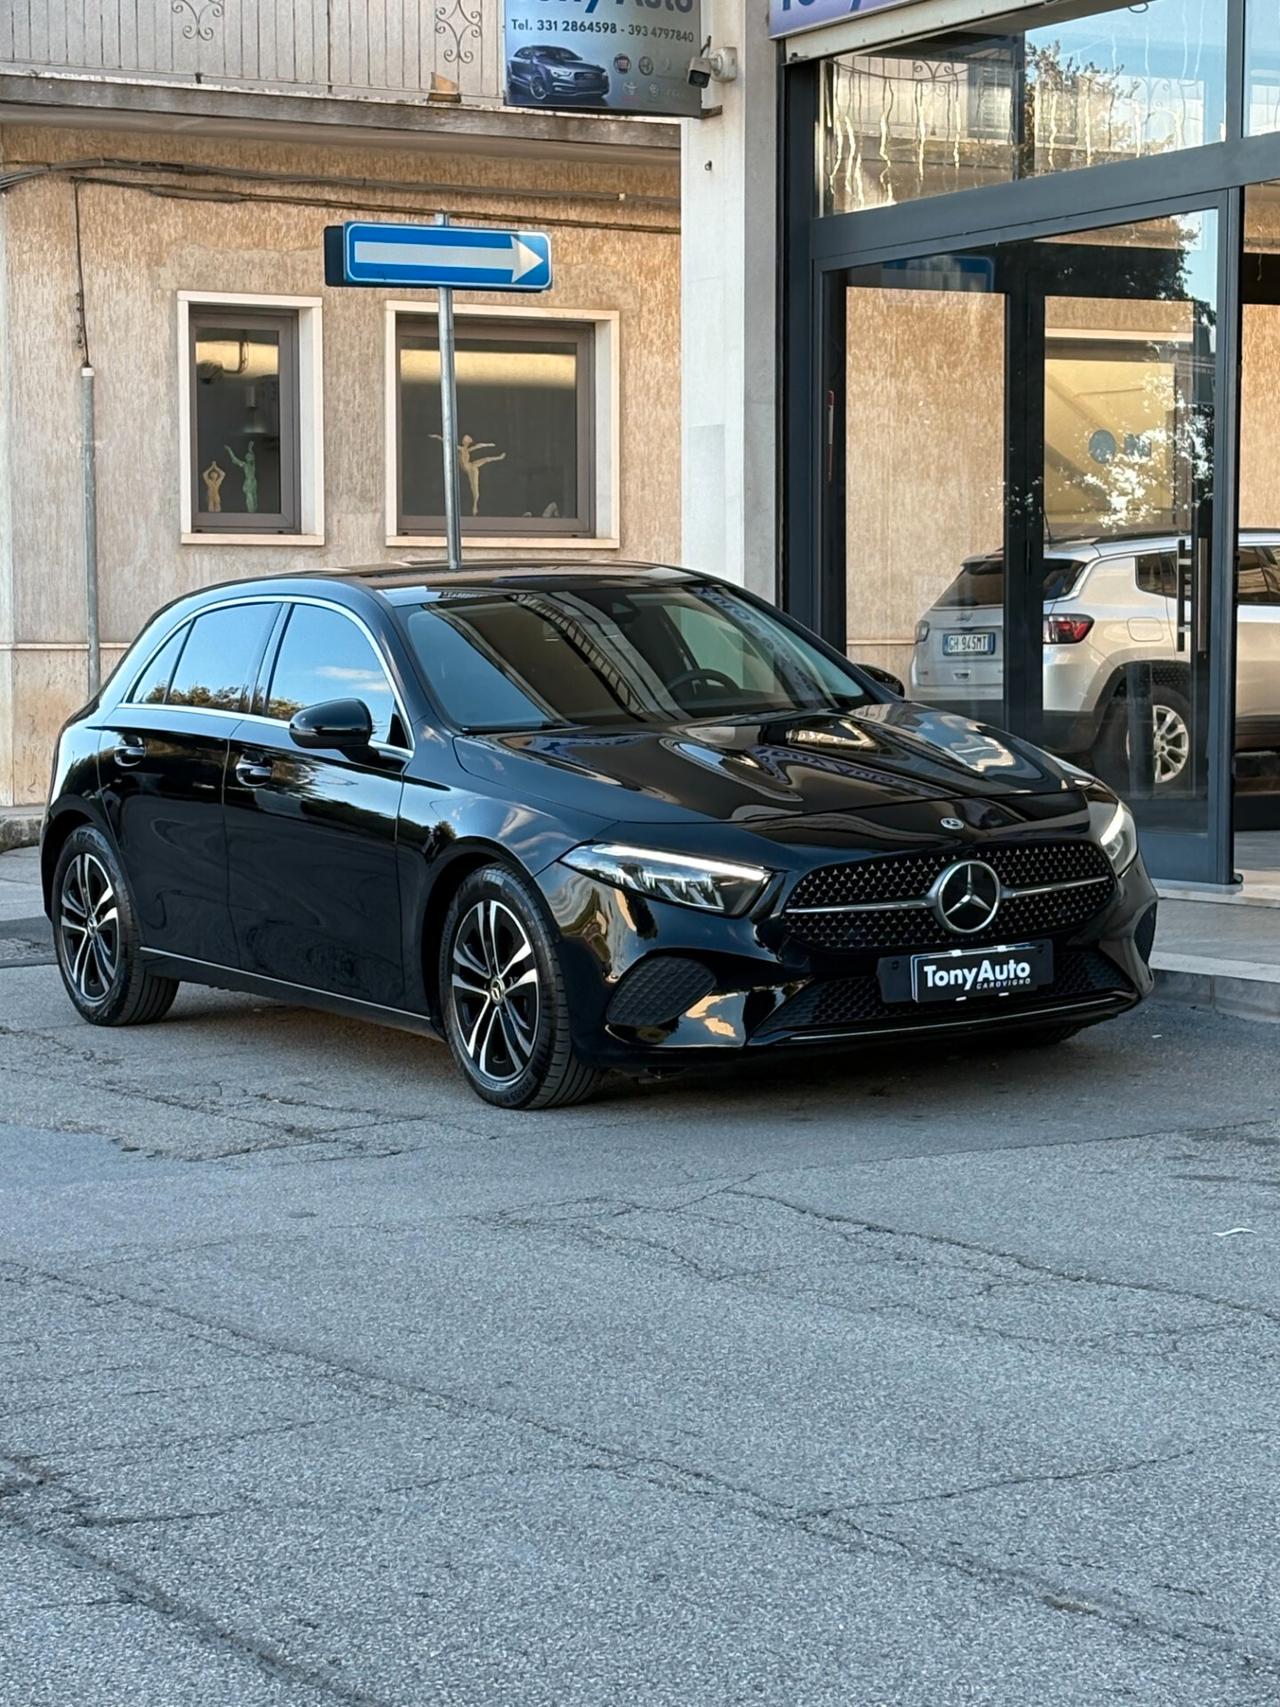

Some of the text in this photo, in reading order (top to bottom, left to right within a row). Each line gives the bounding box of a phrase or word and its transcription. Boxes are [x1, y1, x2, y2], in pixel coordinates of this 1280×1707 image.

[511, 19, 533, 31] Tel.
[537, 19, 558, 31] 331
[562, 20, 617, 34] 2864598
[628, 24, 648, 37] 393
[650, 26, 694, 42] 4797840
[923, 959, 1031, 991] TonyAuto
[976, 977, 1031, 990] CAROVIGNO
